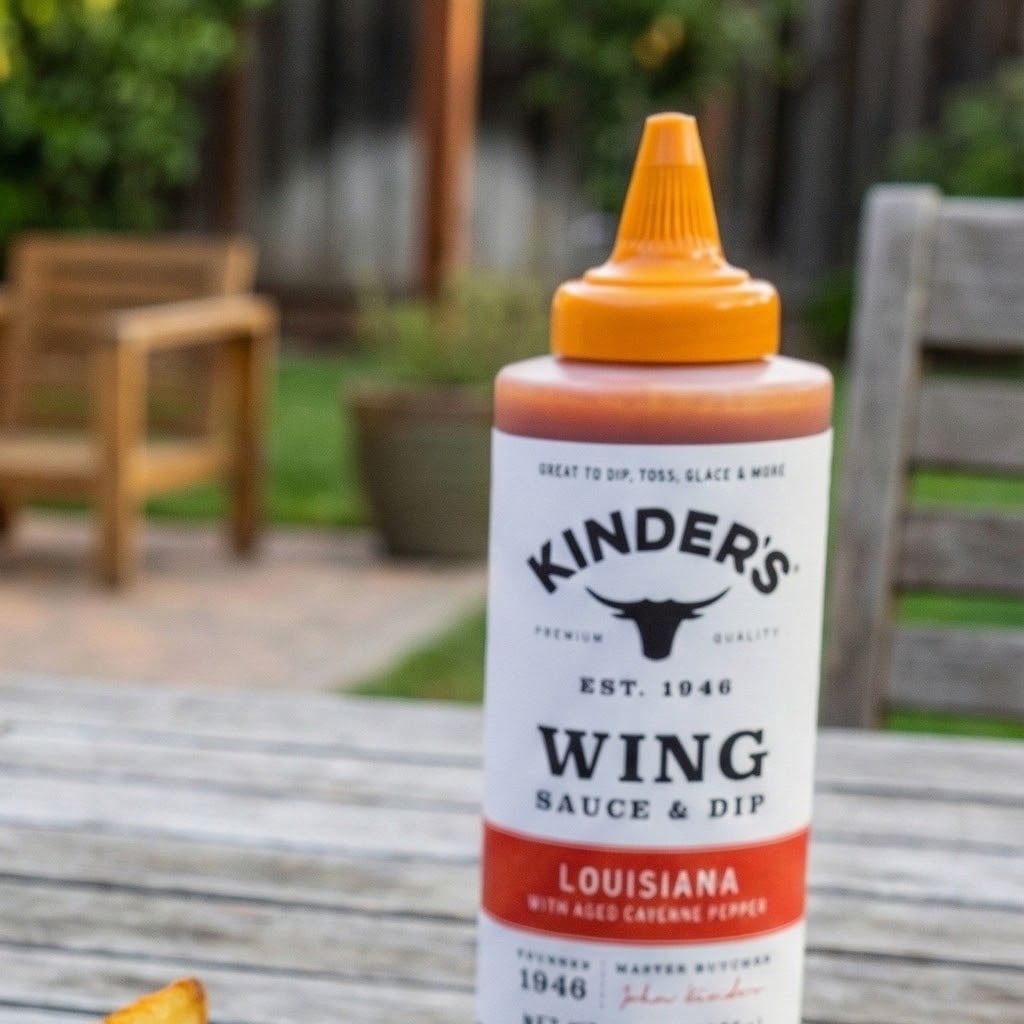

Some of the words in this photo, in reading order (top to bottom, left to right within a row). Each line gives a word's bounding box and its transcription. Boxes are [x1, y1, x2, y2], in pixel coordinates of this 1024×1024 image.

[539, 463, 578, 478] GREAT
[585, 467, 601, 481] TO
[737, 467, 746, 480] &
[751, 463, 786, 478] MORE
[526, 507, 790, 595] KINDER'S
[535, 625, 603, 643] PREMIUM
[713, 628, 780, 644] QUALITY
[580, 677, 645, 697] EST.
[663, 679, 733, 697] 1946
[537, 723, 768, 783] WING
[535, 789, 650, 819] SAUCE
[668, 800, 689, 820] &
[709, 794, 766, 818] DIP
[558, 862, 740, 899] LOUISIANA
[520, 967, 588, 1000] 1946
